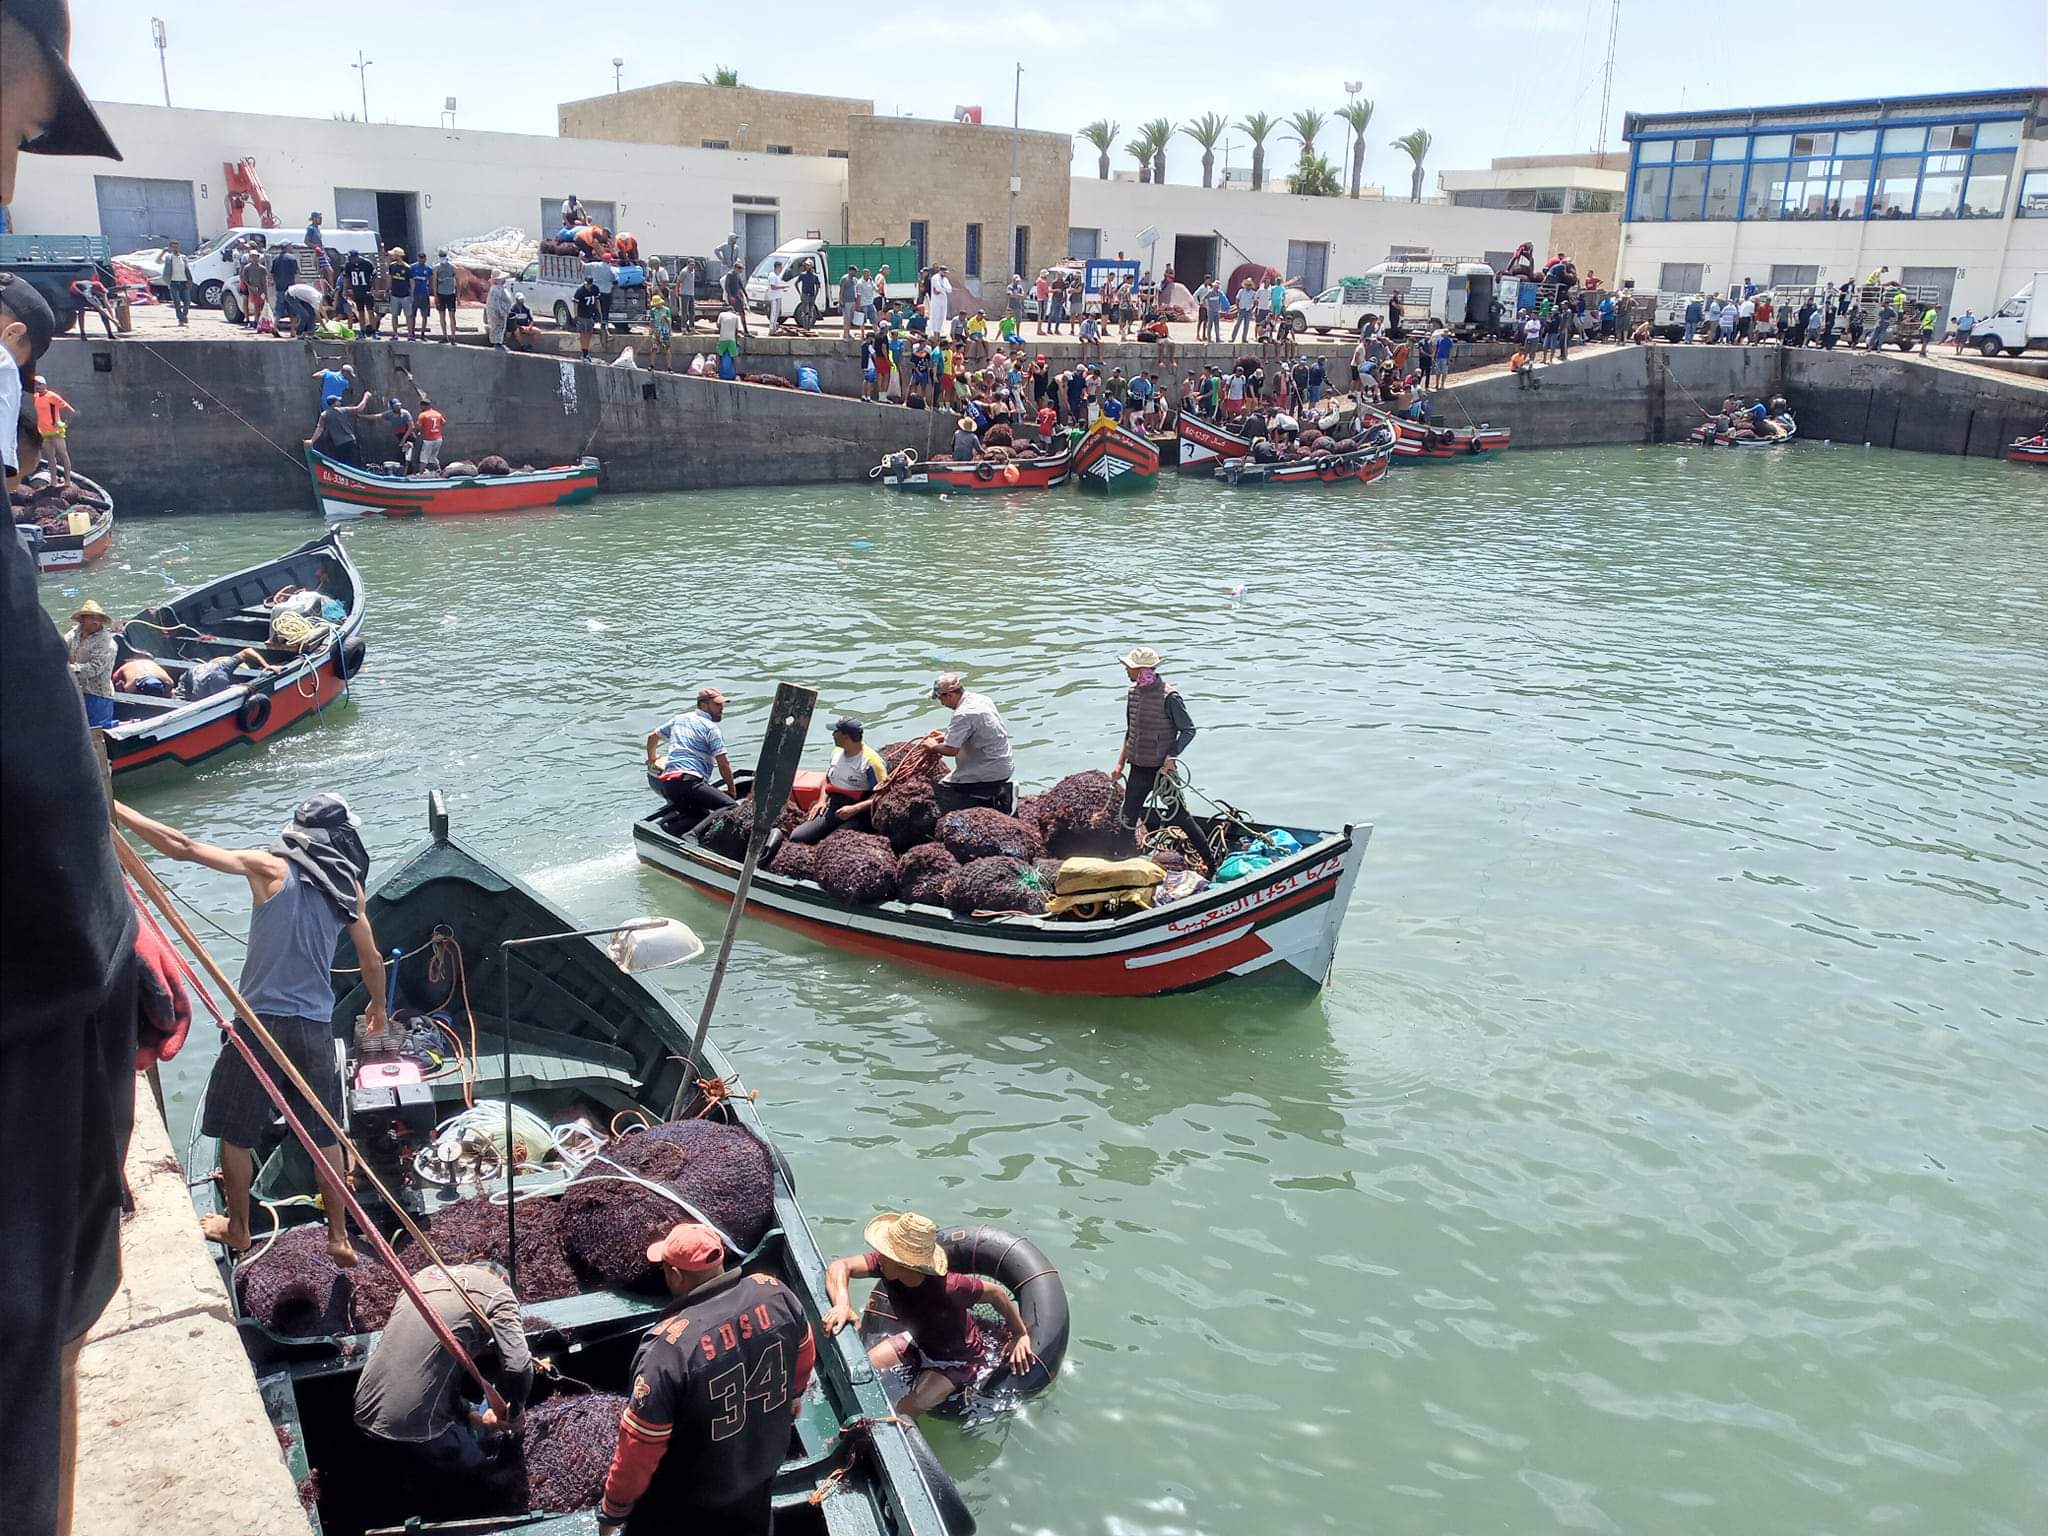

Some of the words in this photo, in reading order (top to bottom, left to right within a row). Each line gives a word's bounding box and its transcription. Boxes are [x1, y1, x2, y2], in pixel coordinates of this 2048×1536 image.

[200, 183, 208, 199] 9
[351, 271, 368, 286] 81
[700, 1303, 772, 1361] SDSU
[708, 1340, 788, 1442] 34
